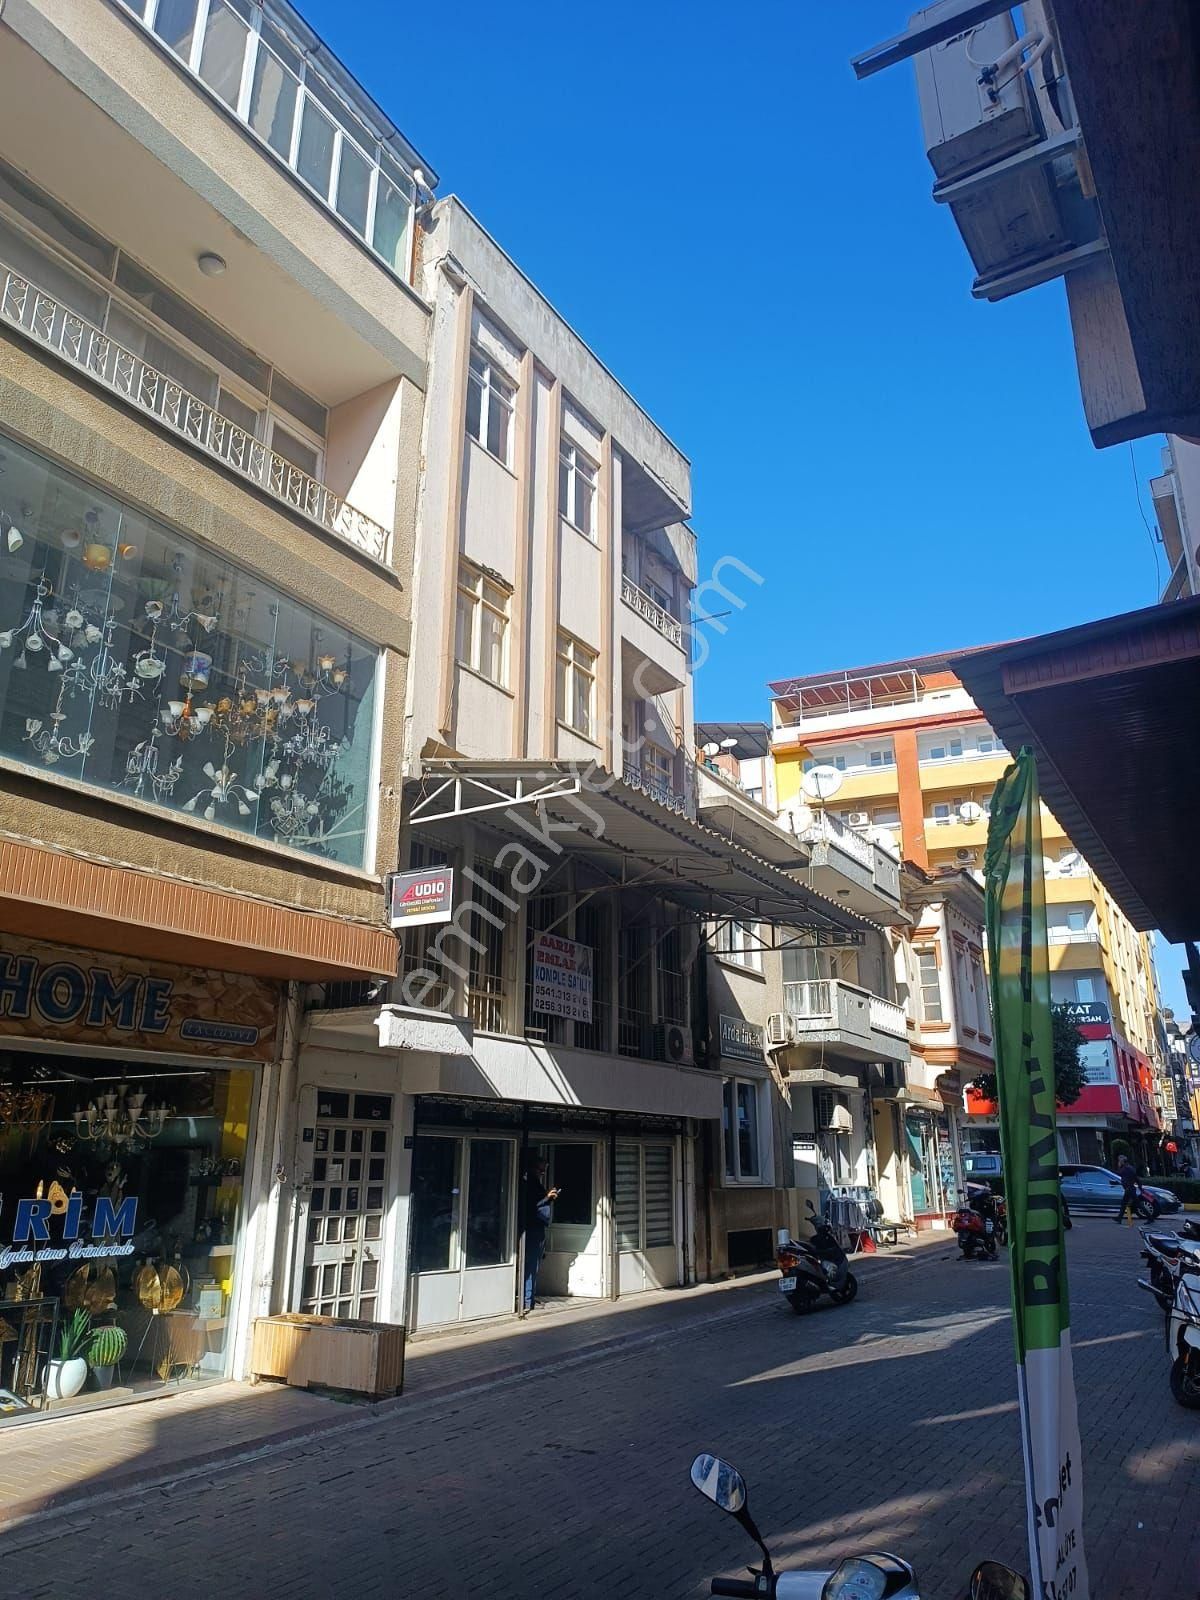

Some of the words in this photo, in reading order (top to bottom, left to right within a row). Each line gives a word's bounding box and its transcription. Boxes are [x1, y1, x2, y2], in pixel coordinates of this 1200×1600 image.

[401, 882, 445, 902] AUDIO
[539, 935, 576, 958] BARIŞ
[536, 950, 577, 972] EMLAK
[535, 964, 566, 987] KOMPLE
[0, 953, 174, 1035] HOME
[0, 1191, 139, 1242] RİM
[69, 1238, 135, 1259] Ürünlerinde
